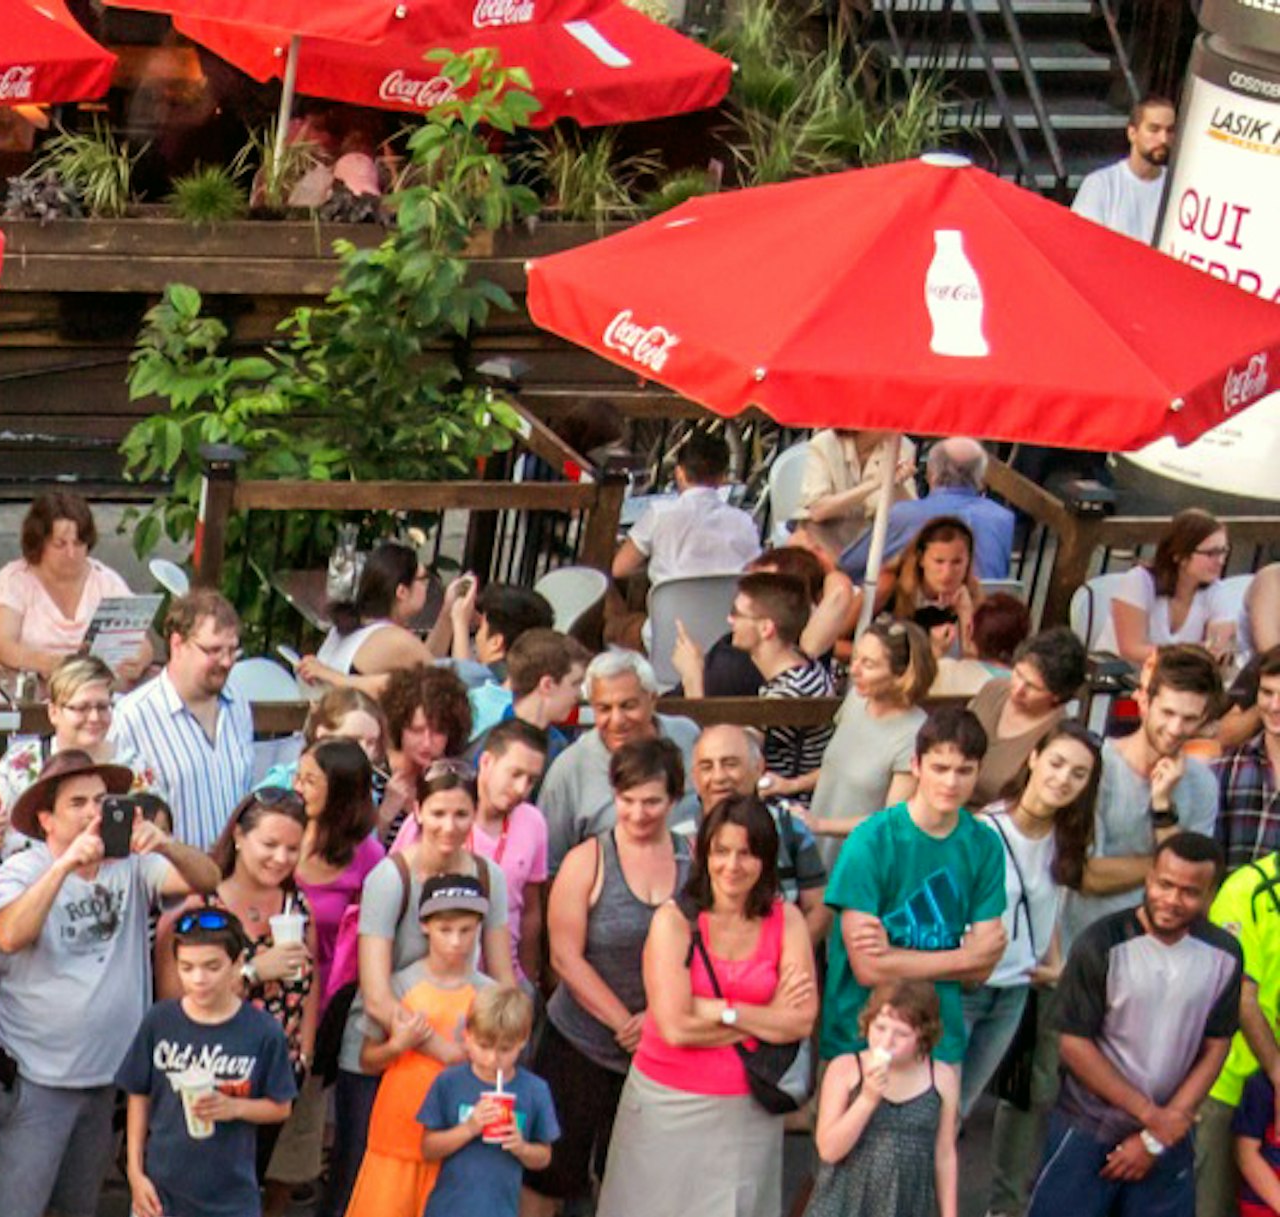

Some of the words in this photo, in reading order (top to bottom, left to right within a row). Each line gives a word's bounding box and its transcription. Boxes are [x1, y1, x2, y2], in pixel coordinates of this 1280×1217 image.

[1210, 106, 1272, 141] LASIK
[1178, 187, 1251, 250] QUI
[153, 1039, 192, 1070] Old
[194, 1042, 257, 1078] Navy
